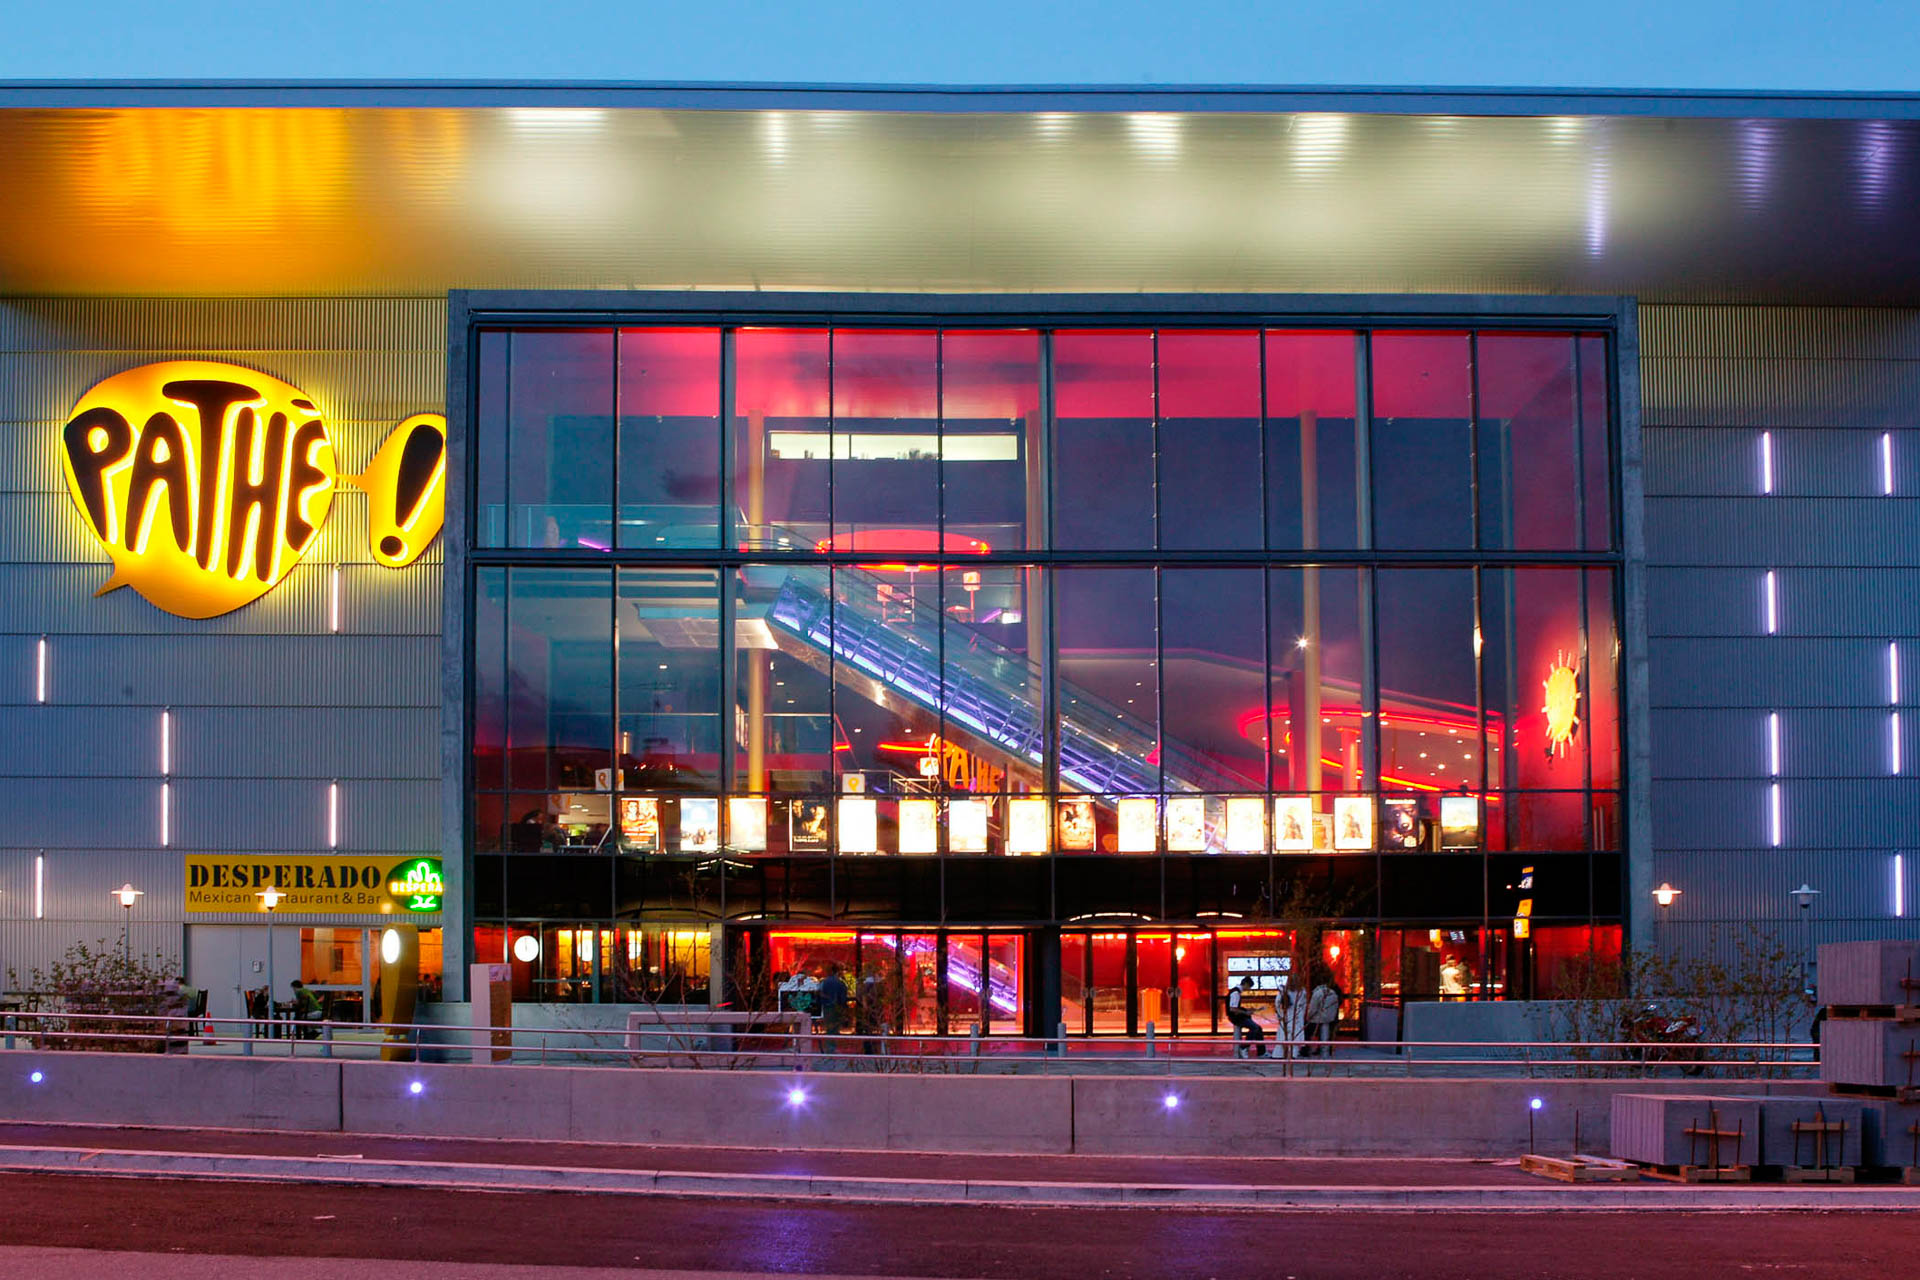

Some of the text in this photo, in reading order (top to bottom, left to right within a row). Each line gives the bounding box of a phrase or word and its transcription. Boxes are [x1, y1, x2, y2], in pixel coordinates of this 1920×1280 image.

[189, 864, 381, 889] DESPERADO
[189, 890, 381, 905] Mexican staurant & Bar
